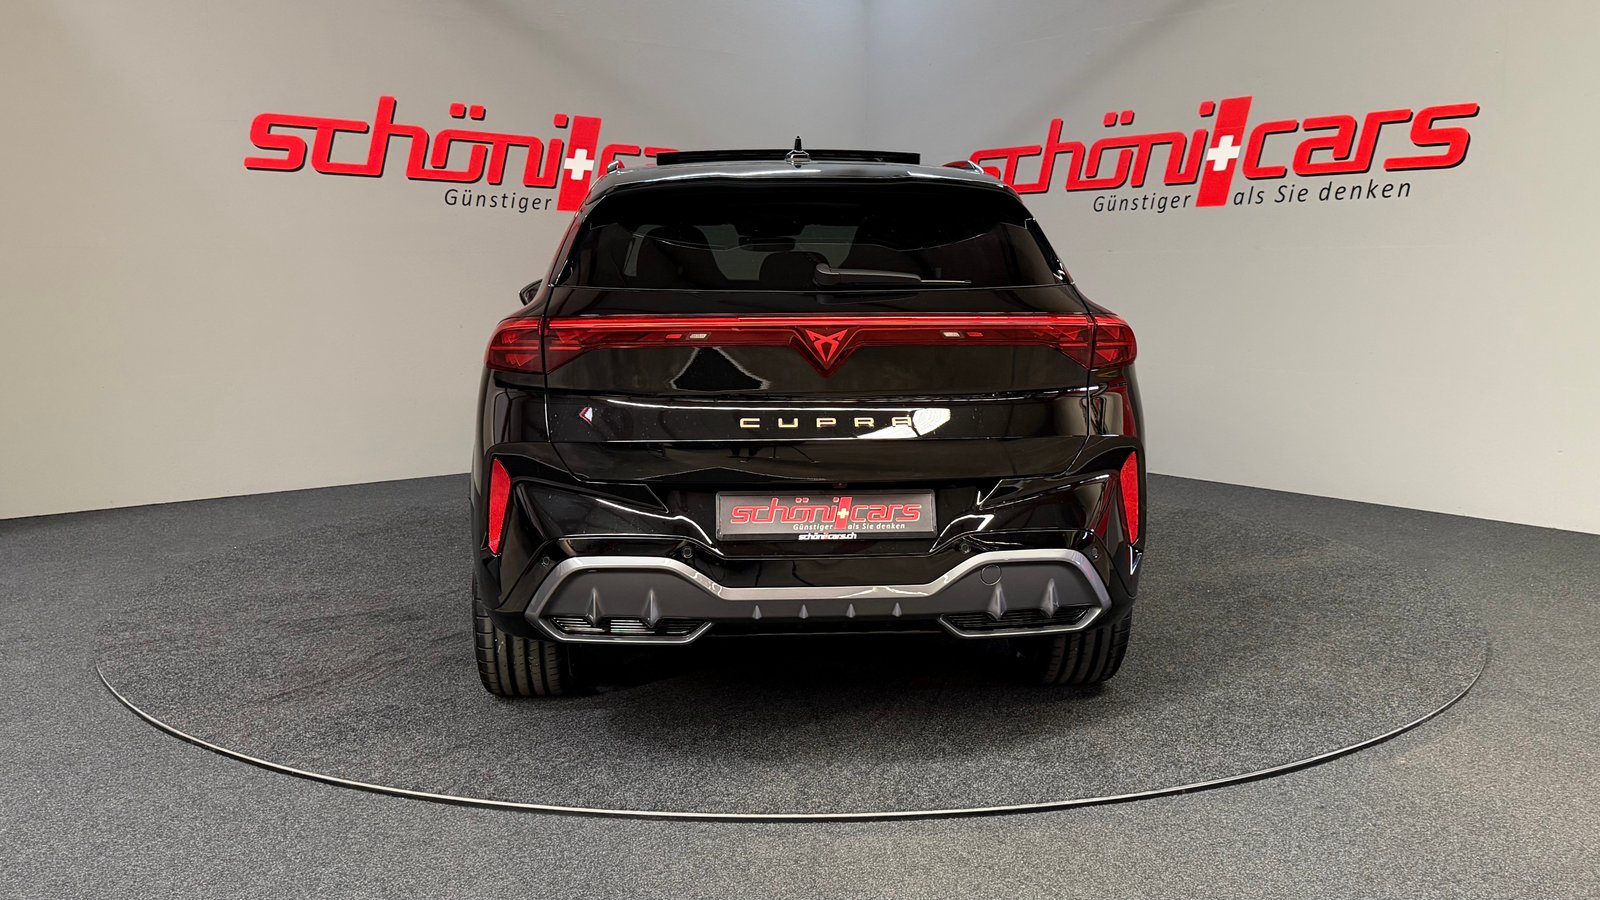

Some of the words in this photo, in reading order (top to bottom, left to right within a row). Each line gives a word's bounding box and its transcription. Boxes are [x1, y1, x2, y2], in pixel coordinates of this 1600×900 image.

[444, 189, 552, 213] Günstiger
[1093, 192, 1192, 214] Günstiger
[1233, 187, 1264, 206] als
[1274, 183, 1307, 204] Sie
[1318, 179, 1412, 202] denken
[739, 416, 912, 428] CUPRA
[793, 523, 833, 531] Günstiger
[876, 522, 905, 530] denken
